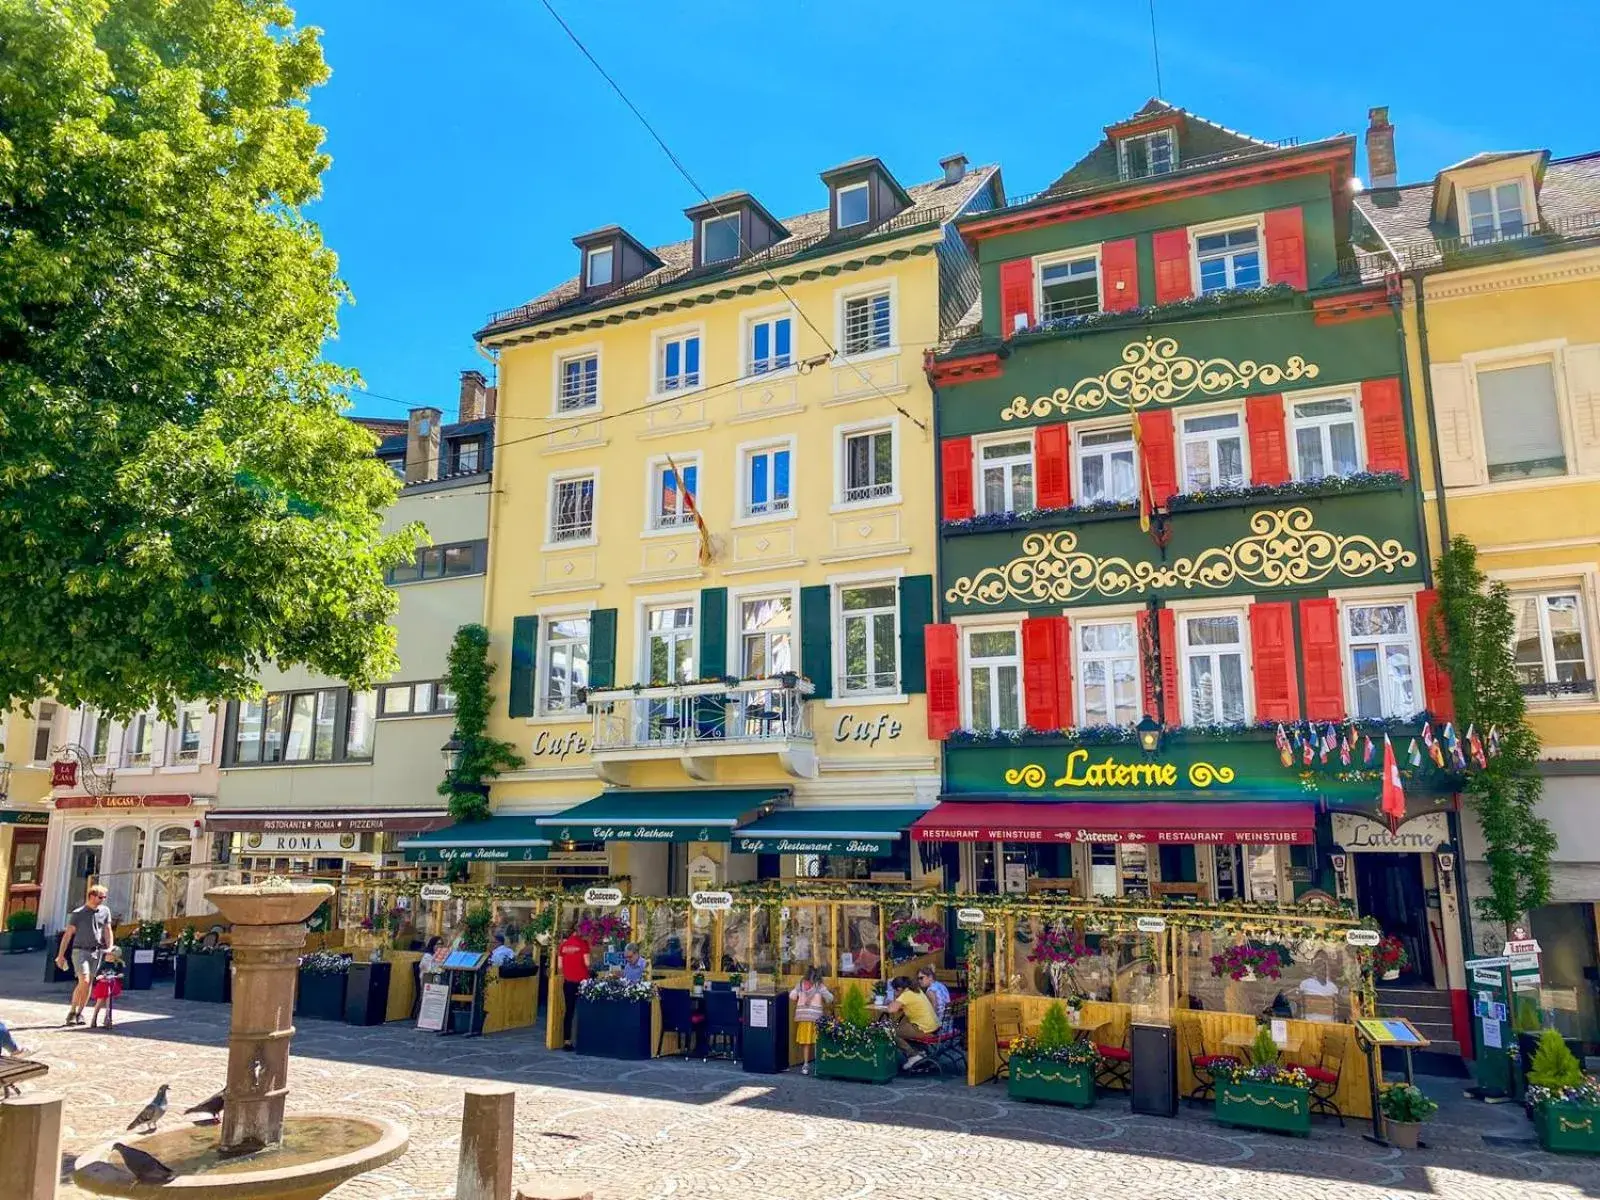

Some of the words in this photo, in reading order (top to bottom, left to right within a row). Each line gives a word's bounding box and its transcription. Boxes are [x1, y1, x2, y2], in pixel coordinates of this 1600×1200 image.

[1054, 749, 1178, 788] Laterne
[116, 796, 134, 806] CASA
[264, 820, 307, 829] RISTORANTE
[314, 820, 335, 829] ROMA
[350, 820, 384, 829] PIZZERIA
[592, 827, 614, 840] Cafe
[633, 827, 674, 838] Rathaus
[922, 830, 979, 838] RESTAURANT
[988, 831, 1042, 839] WEINSTUBE
[1075, 829, 1119, 842] Laterne
[1158, 832, 1224, 841] RESTAURANT
[1235, 832, 1298, 841] WEINSTUBE
[1346, 824, 1434, 848] Laterne
[277, 837, 322, 850] ROMA
[741, 839, 764, 853] Cafe
[776, 839, 832, 851] Restaurant
[846, 840, 879, 852] Bistro
[439, 848, 457, 861] Cafe
[474, 848, 509, 858] Rathaus
